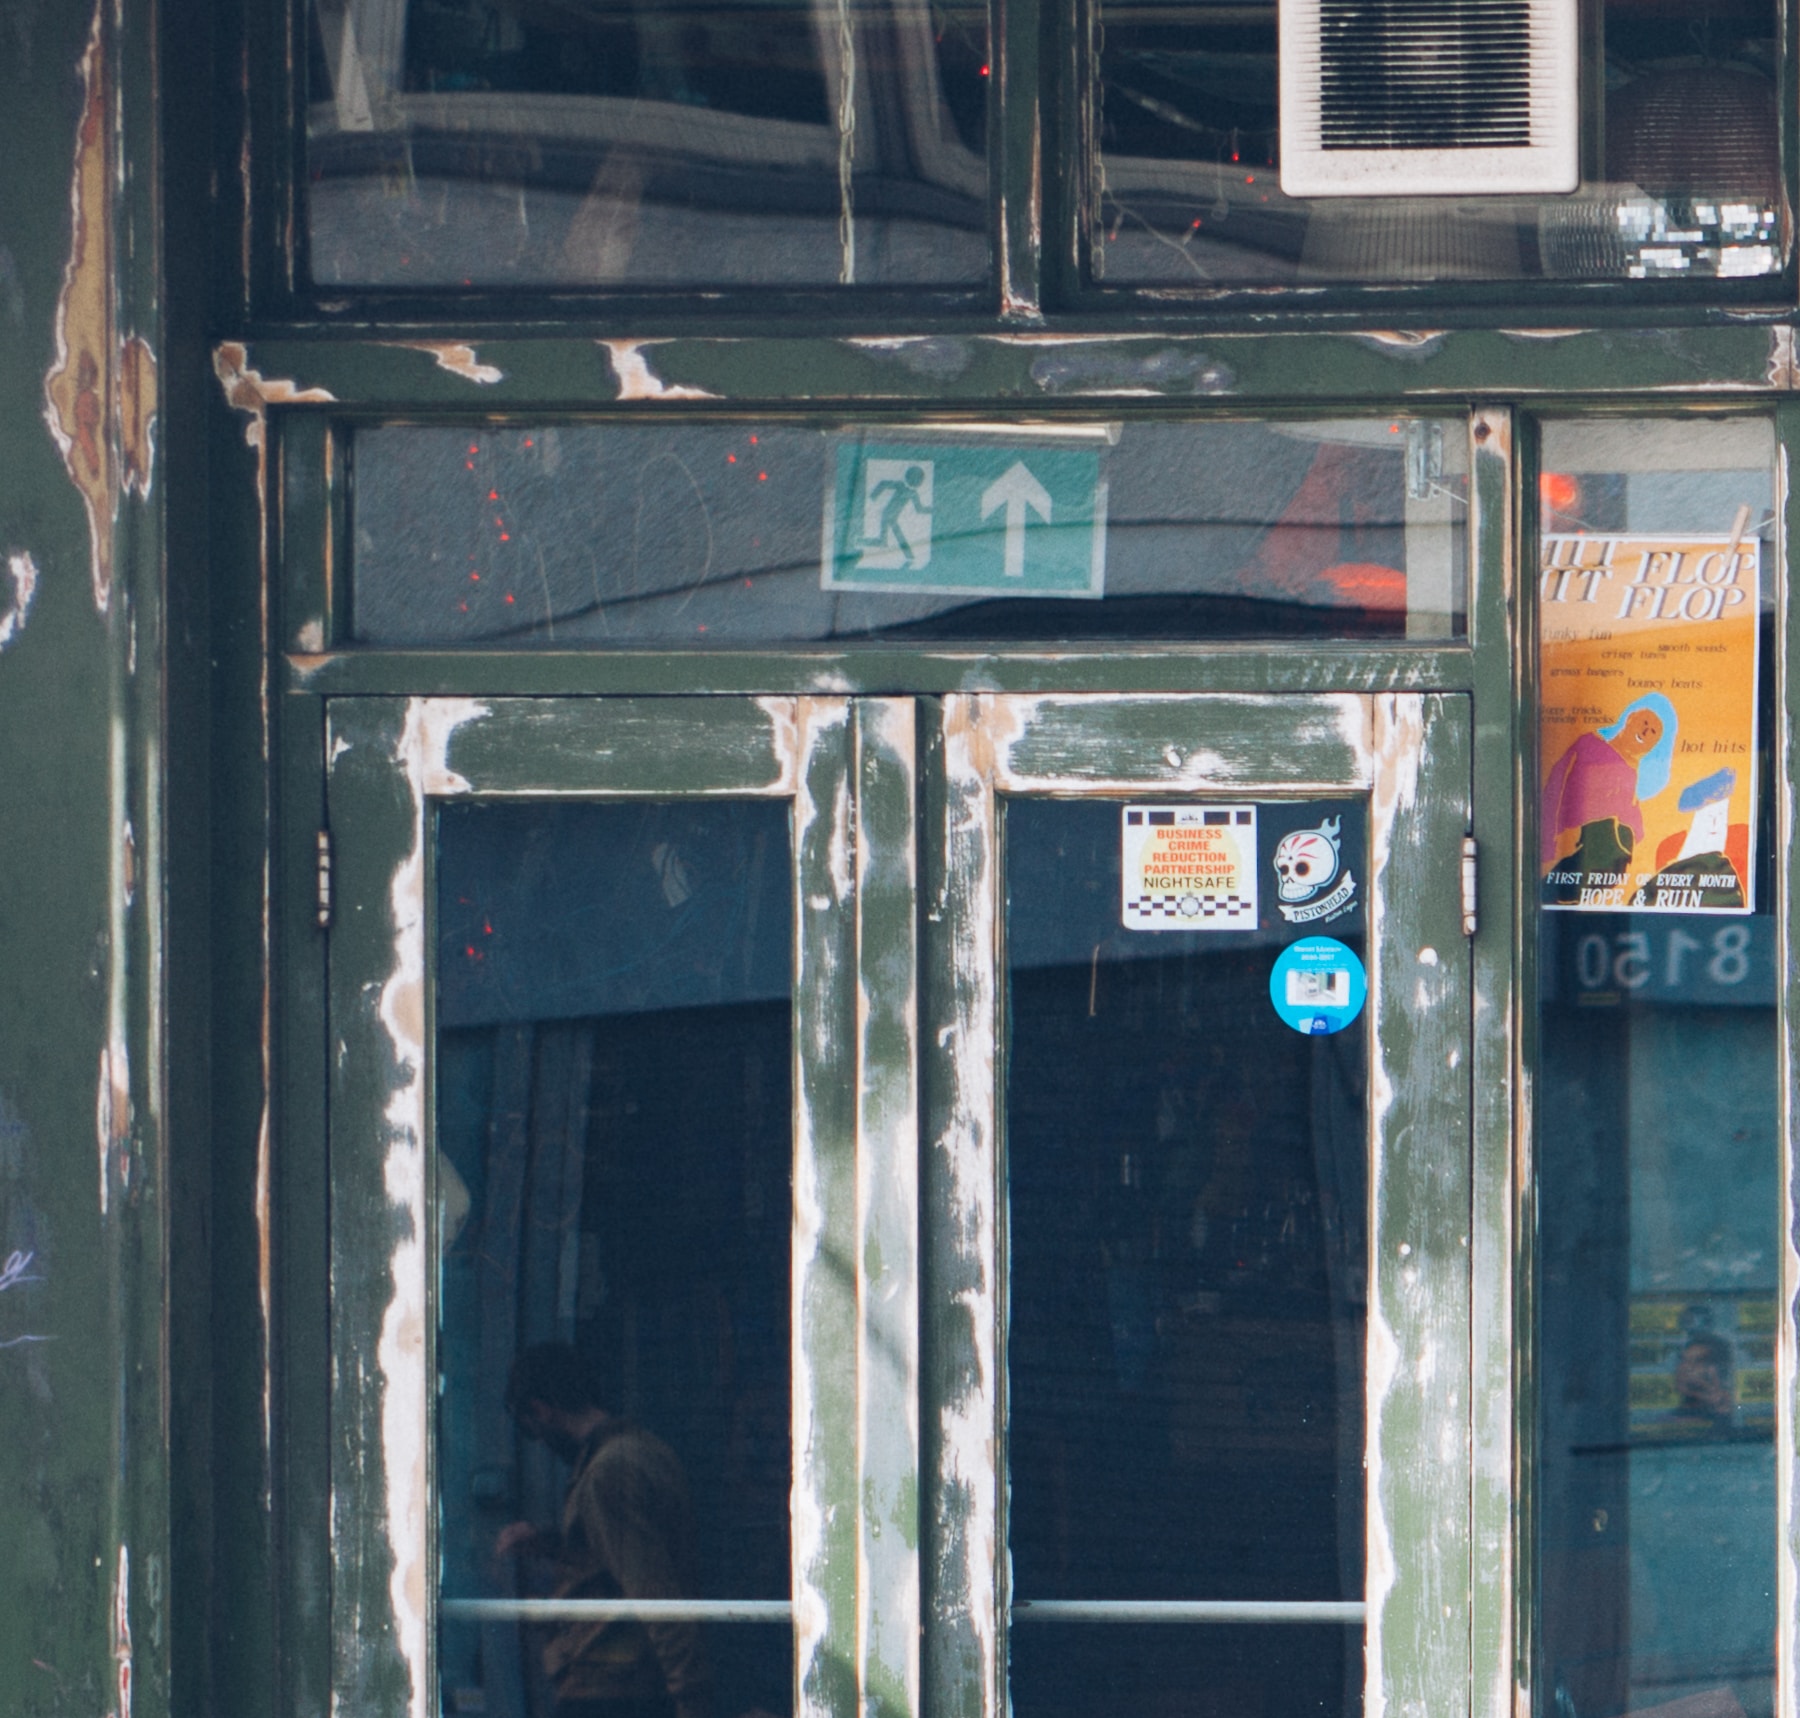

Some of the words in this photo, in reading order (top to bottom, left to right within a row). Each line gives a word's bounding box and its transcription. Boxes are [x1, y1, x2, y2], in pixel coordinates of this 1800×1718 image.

[1633, 551, 1756, 586] FLOP
[1615, 585, 1746, 621] FLOP
[1601, 649, 1633, 661] crispy
[1627, 677, 1666, 690] bouncy
[1671, 678, 1703, 689] beats
[1681, 739, 1705, 753] hot
[1712, 739, 1747, 753] hits
[1156, 829, 1222, 839] BUSINESS
[1168, 841, 1211, 851] CRIME
[1152, 852, 1227, 862] REDUCTION
[1144, 864, 1235, 874] PARTNERSHIP
[1144, 876, 1236, 889] NIGHTSAFE
[1547, 872, 1583, 885] FIRST
[1587, 872, 1631, 886] FRIDAY
[1635, 873, 1651, 886] OF
[1656, 874, 1695, 887] EVERY
[1699, 874, 1737, 888] MONTH
[1293, 886, 1350, 921] PISTONHEAD
[1579, 887, 1625, 907] HOPE
[1632, 889, 1647, 907] &
[1656, 889, 1704, 908] RUIN
